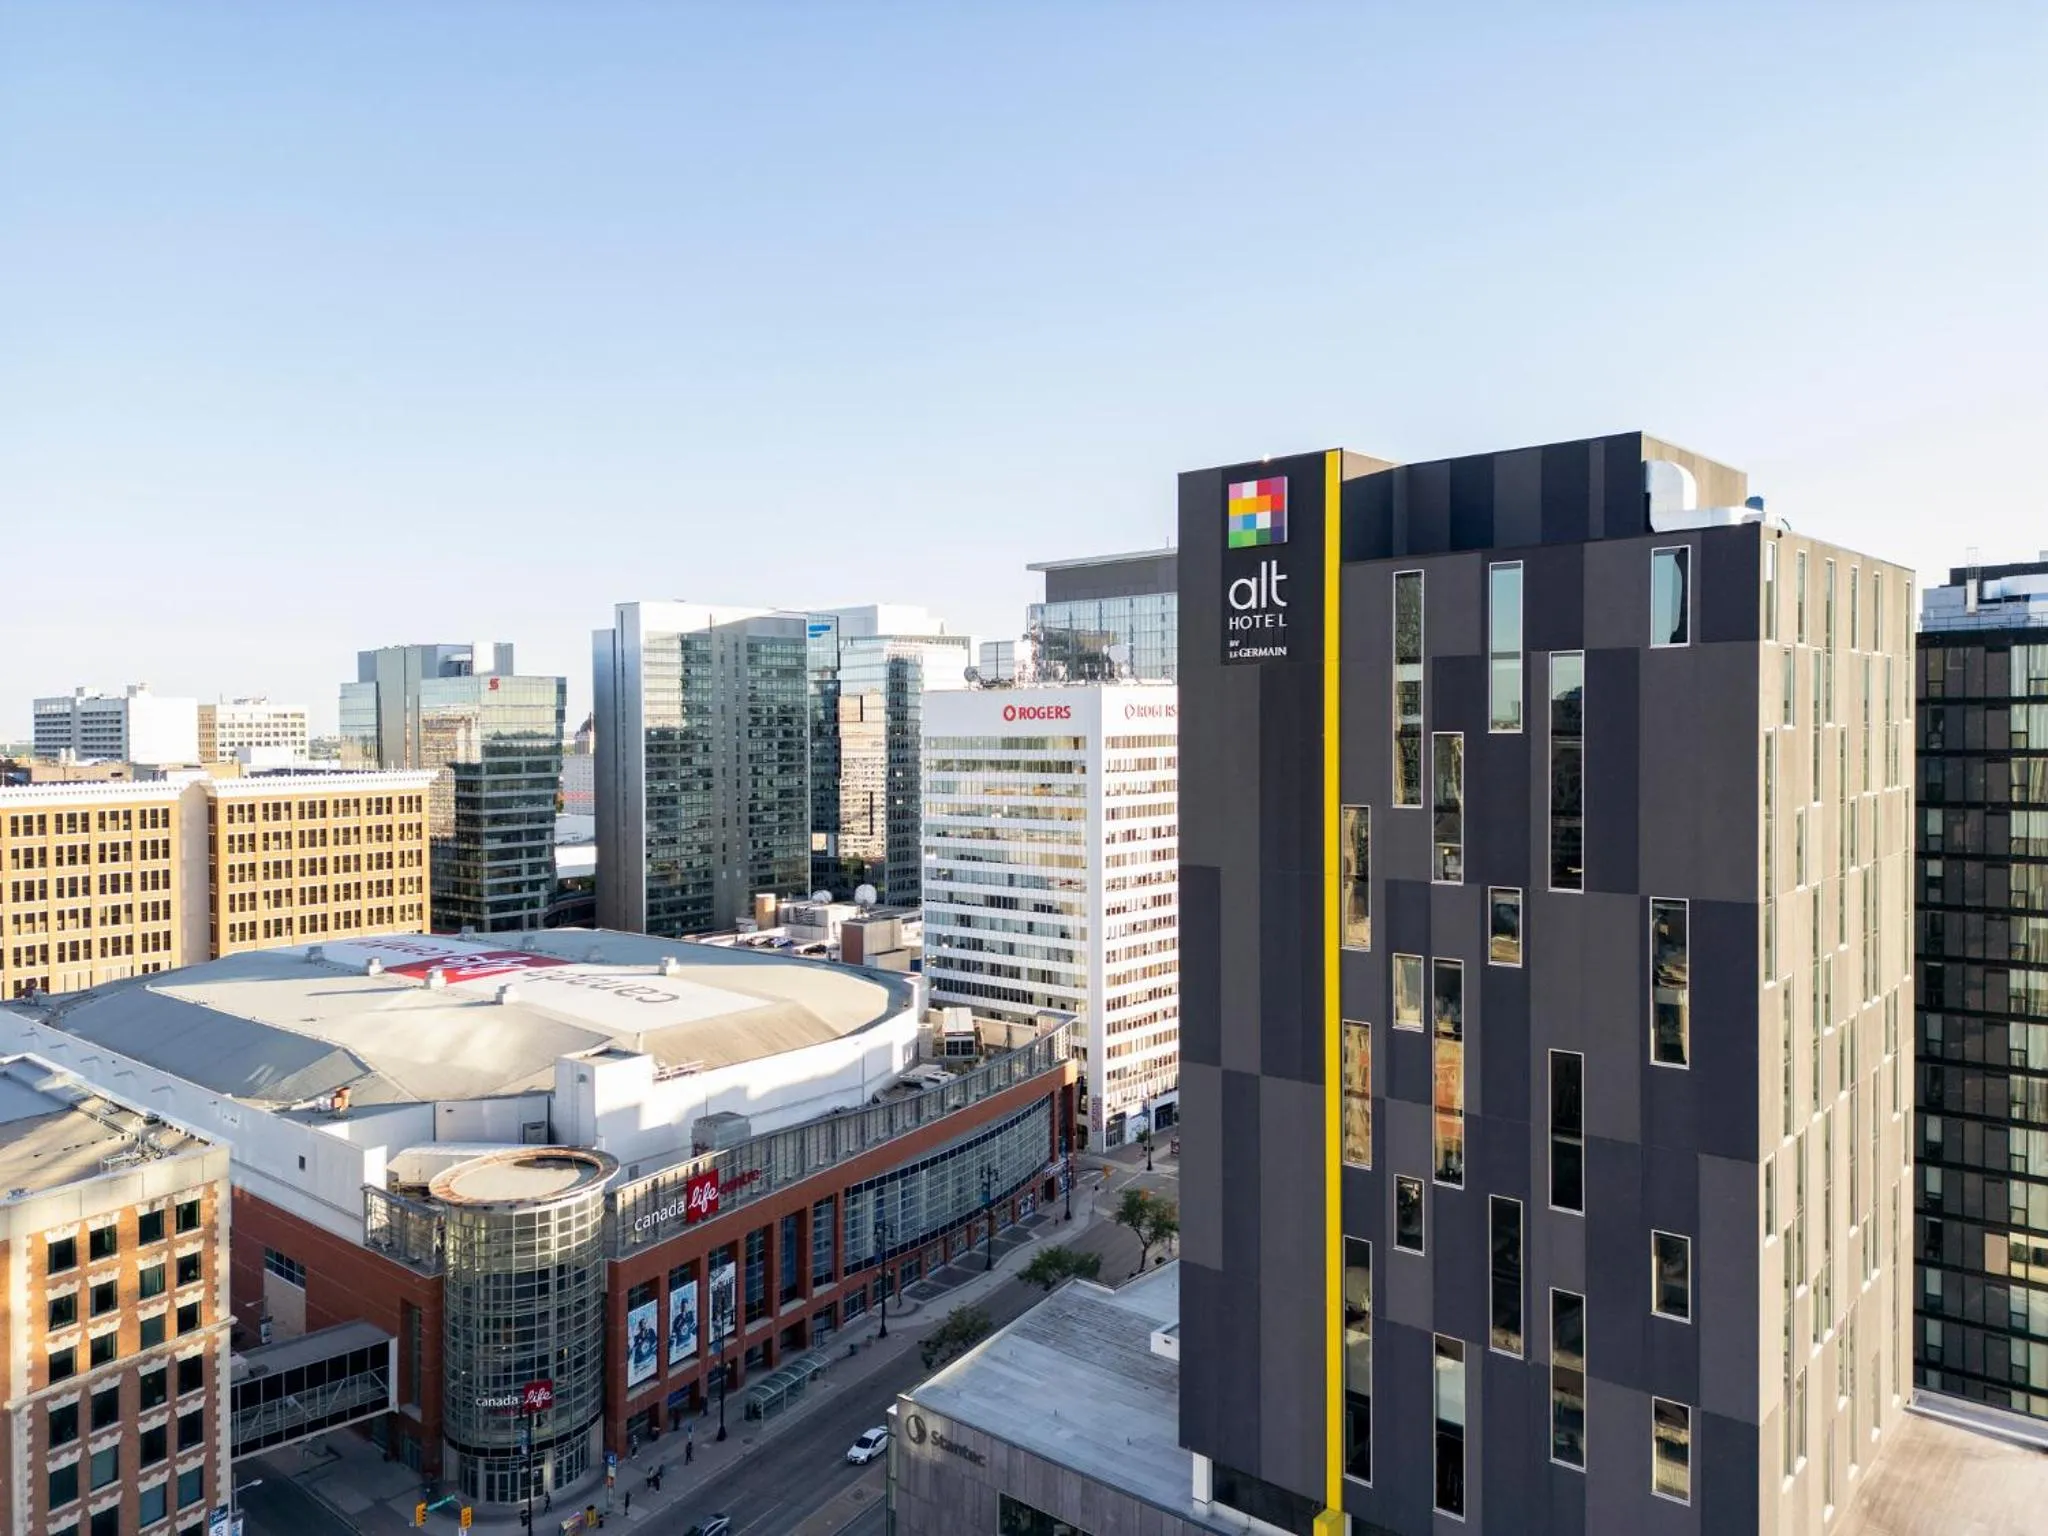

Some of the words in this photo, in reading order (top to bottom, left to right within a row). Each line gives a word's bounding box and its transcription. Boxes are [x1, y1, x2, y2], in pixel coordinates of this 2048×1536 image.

[1229, 560, 1288, 610] alt
[1229, 613, 1288, 630] HOTEL
[1019, 705, 1072, 720] ROGERS
[634, 1198, 685, 1231] canada
[687, 1181, 719, 1213] life
[475, 1395, 519, 1407] canada
[524, 1387, 552, 1408] life
[930, 1430, 987, 1468] Stantec
